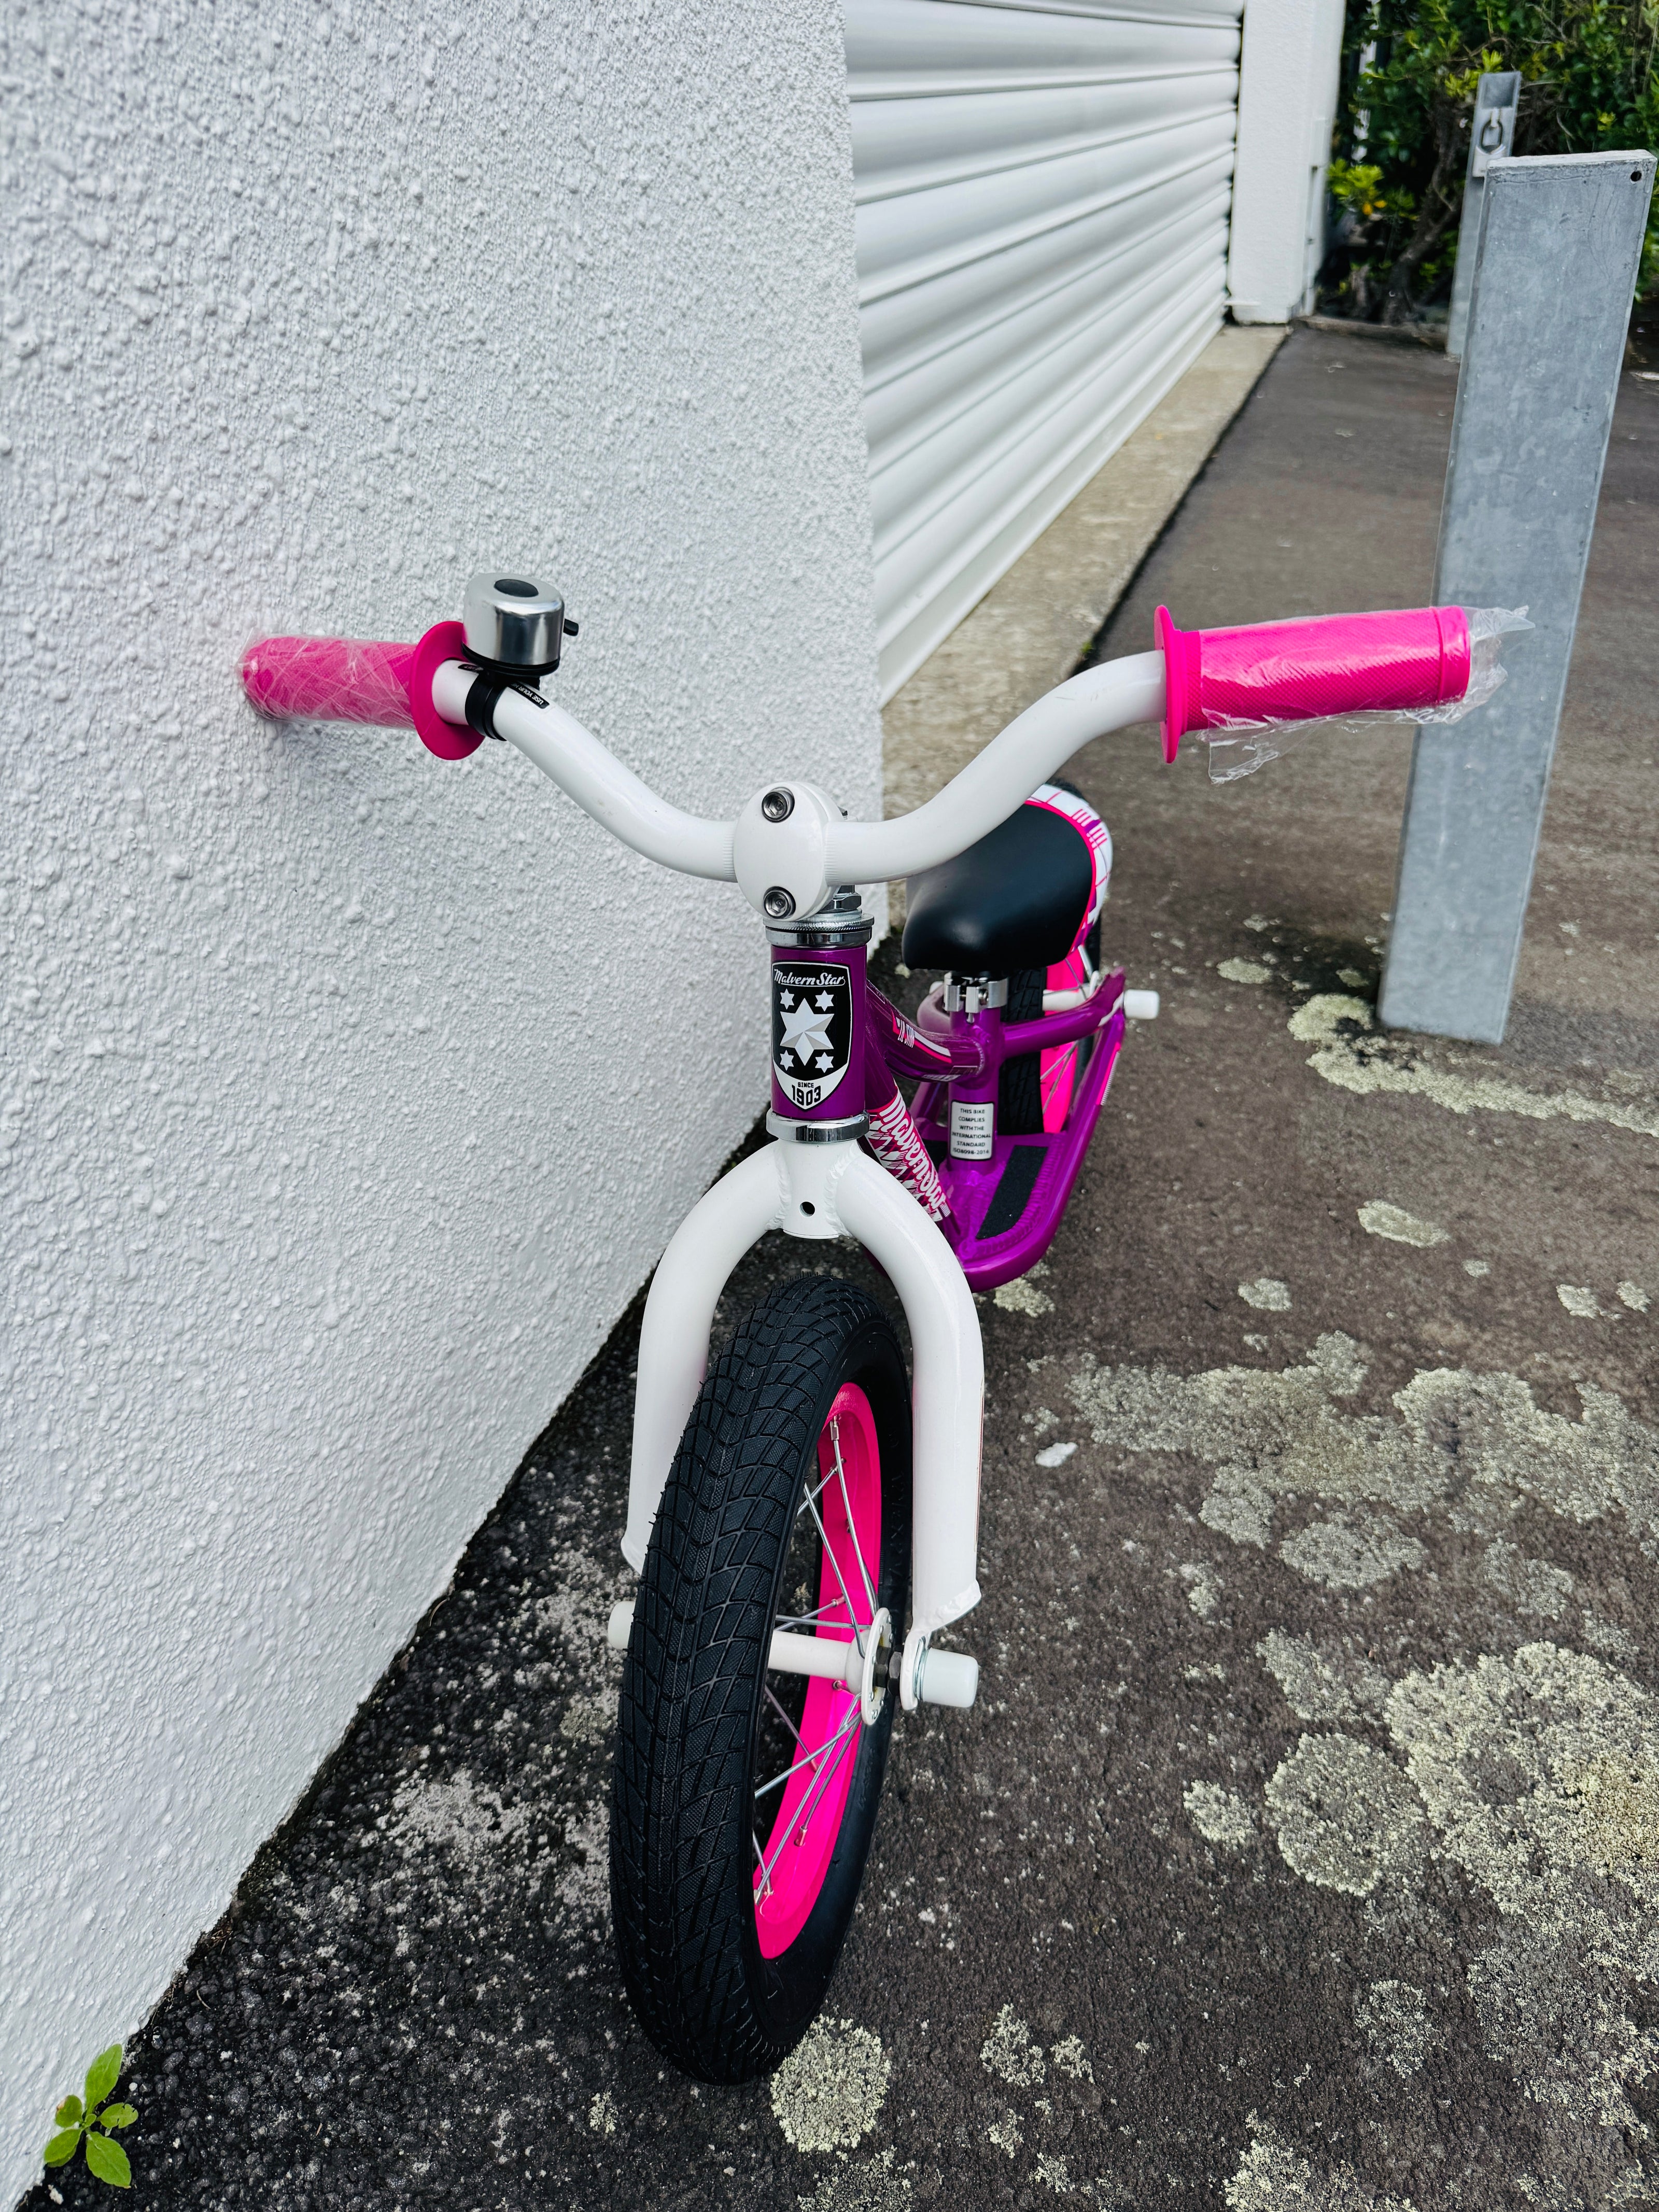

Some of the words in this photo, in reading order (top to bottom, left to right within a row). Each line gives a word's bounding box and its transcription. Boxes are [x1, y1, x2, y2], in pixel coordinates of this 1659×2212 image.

[518, 686, 533, 697] YOUR
[531, 695, 544, 705] USE
[774, 968, 816, 985] Malvern
[816, 972, 846, 987] Star
[791, 1084, 821, 1106] 1903
[879, 1091, 930, 1180] Malvern
